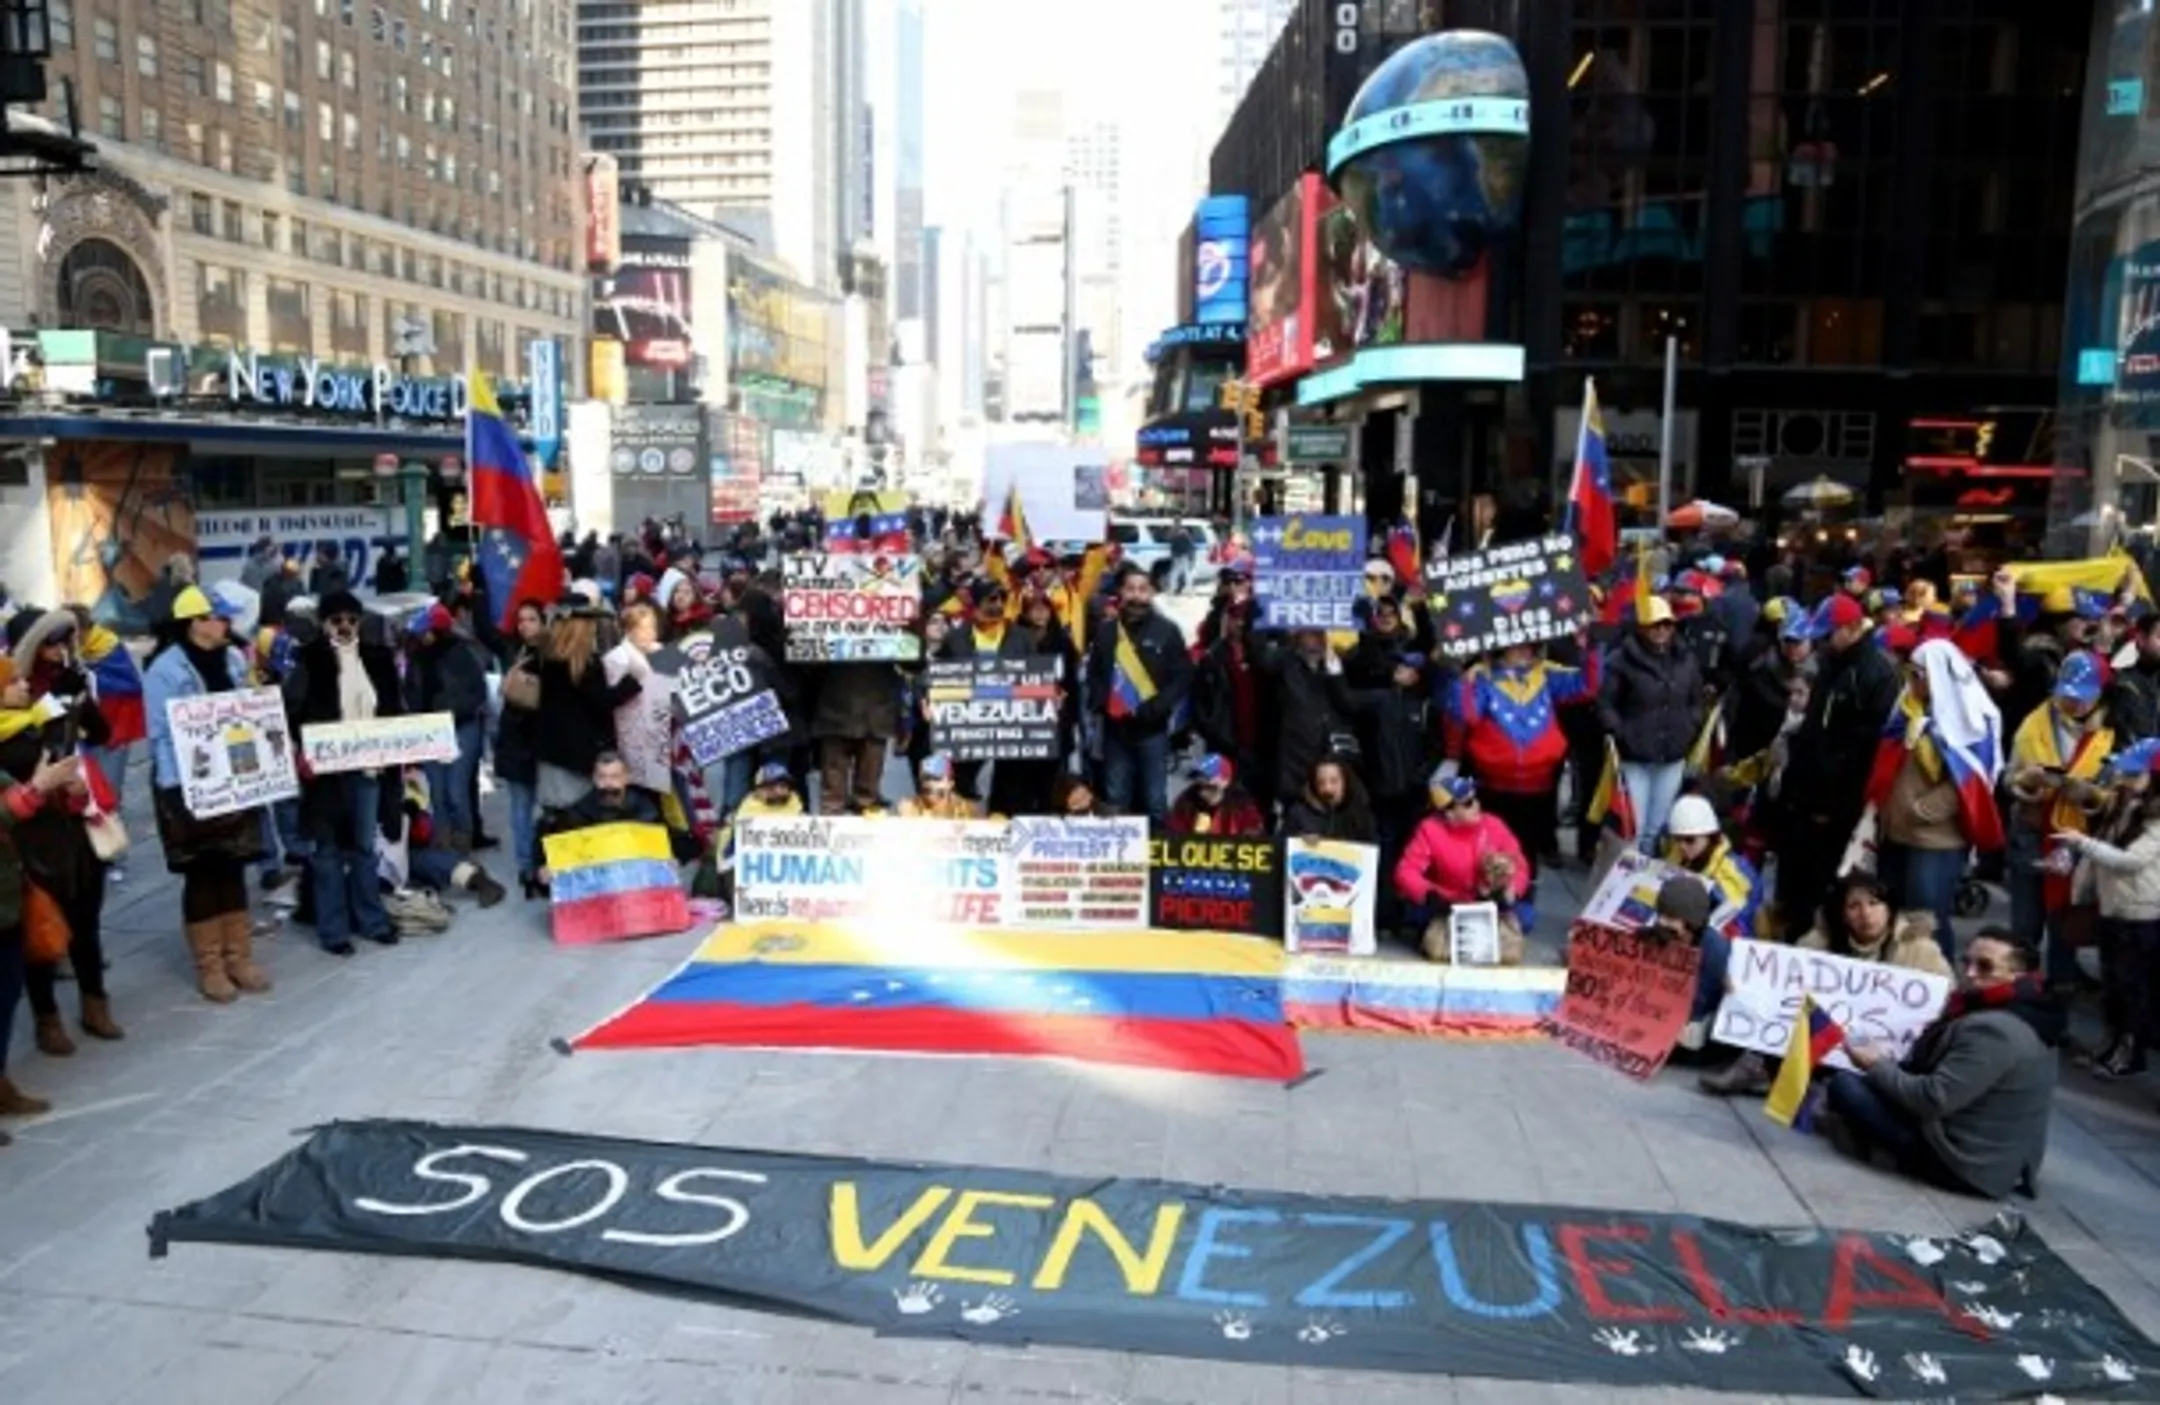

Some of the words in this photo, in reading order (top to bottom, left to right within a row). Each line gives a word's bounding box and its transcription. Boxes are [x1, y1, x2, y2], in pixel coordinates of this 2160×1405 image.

[1543, 534, 1573, 554] NO
[791, 555, 828, 576] TV
[787, 592, 918, 622] CENSORED
[1269, 601, 1353, 626] FREE
[681, 663, 754, 718] ECO
[931, 699, 1058, 725] VENEZUELA
[741, 852, 864, 886] HUMAN
[1148, 839, 1178, 867] EL
[1181, 840, 1235, 869] QUE
[1238, 843, 1274, 872] SE
[1160, 896, 1252, 926] PIERDE
[1742, 945, 1930, 1009] MADURO
[355, 1145, 768, 1246] SOS
[830, 1180, 1993, 1343] VENEZUELA
